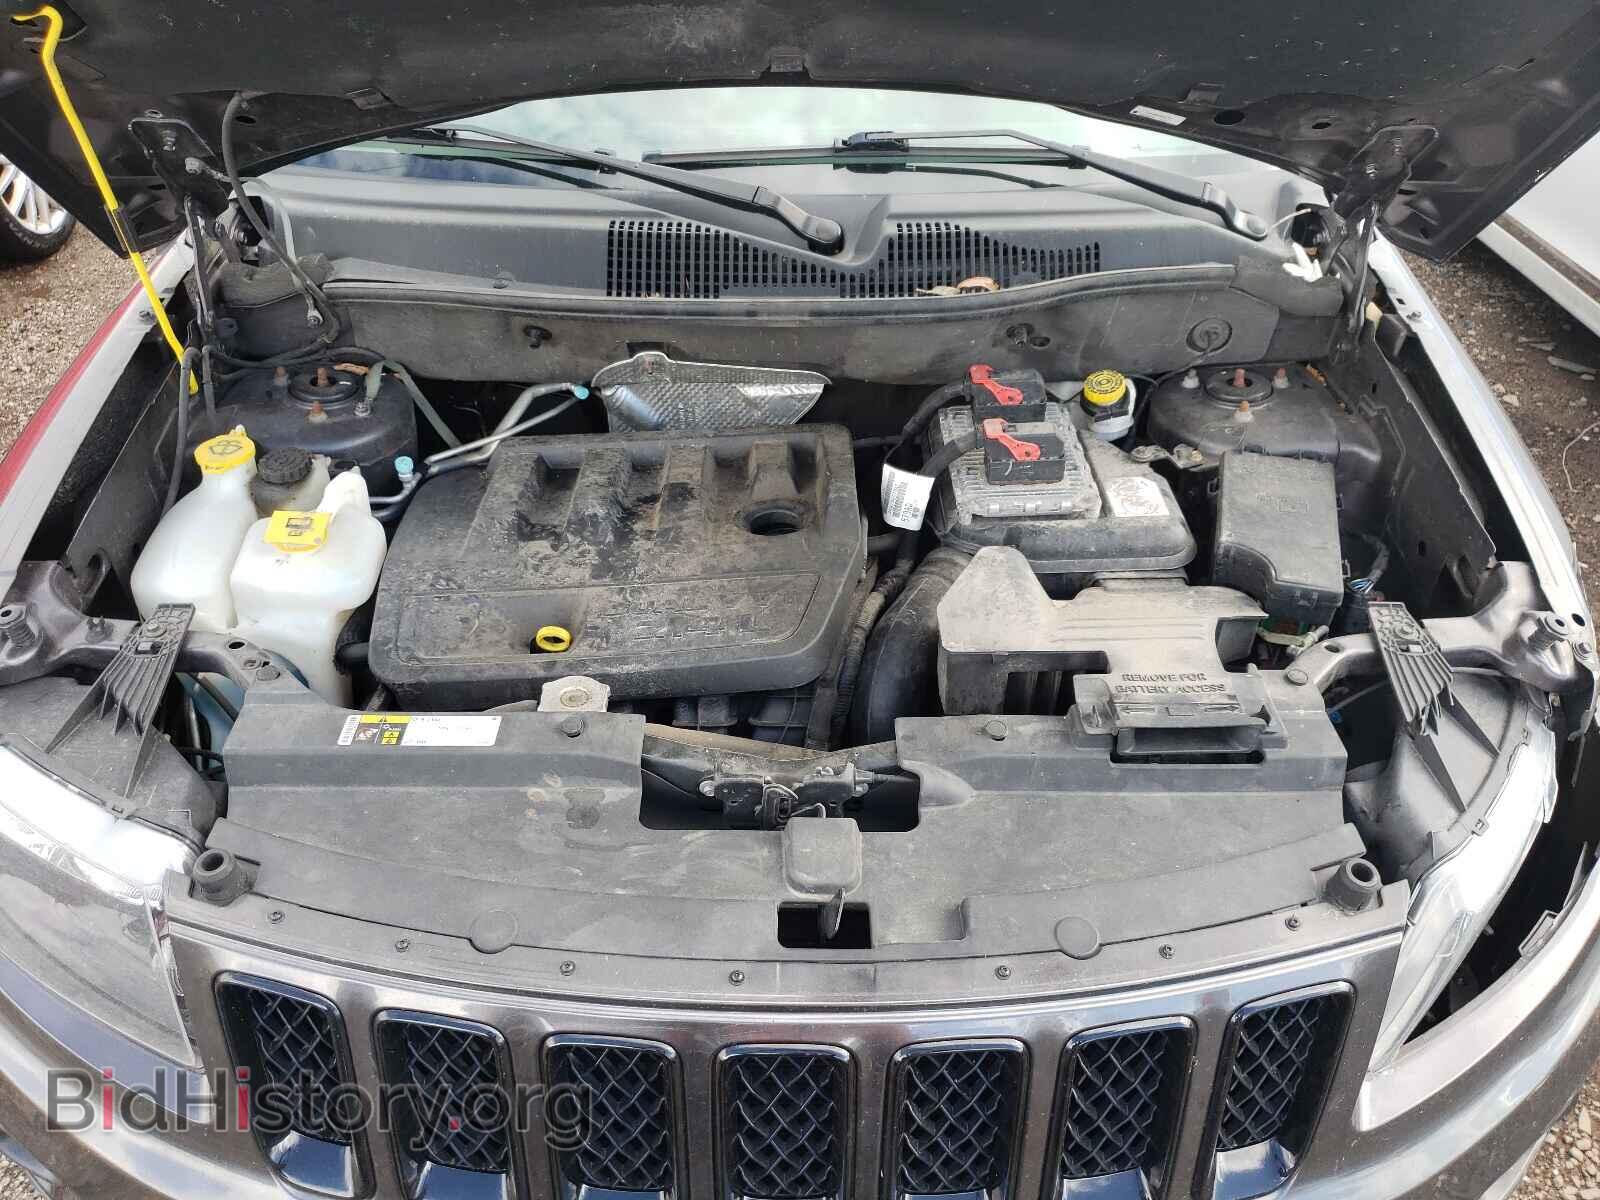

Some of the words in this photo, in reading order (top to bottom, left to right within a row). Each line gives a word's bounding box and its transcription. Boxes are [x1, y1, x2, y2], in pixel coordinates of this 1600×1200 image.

[1121, 672, 1177, 682] REMOVE
[1179, 672, 1207, 681] FOR
[1115, 684, 1170, 694] BATTERY
[1176, 683, 1225, 693] ACCESS
